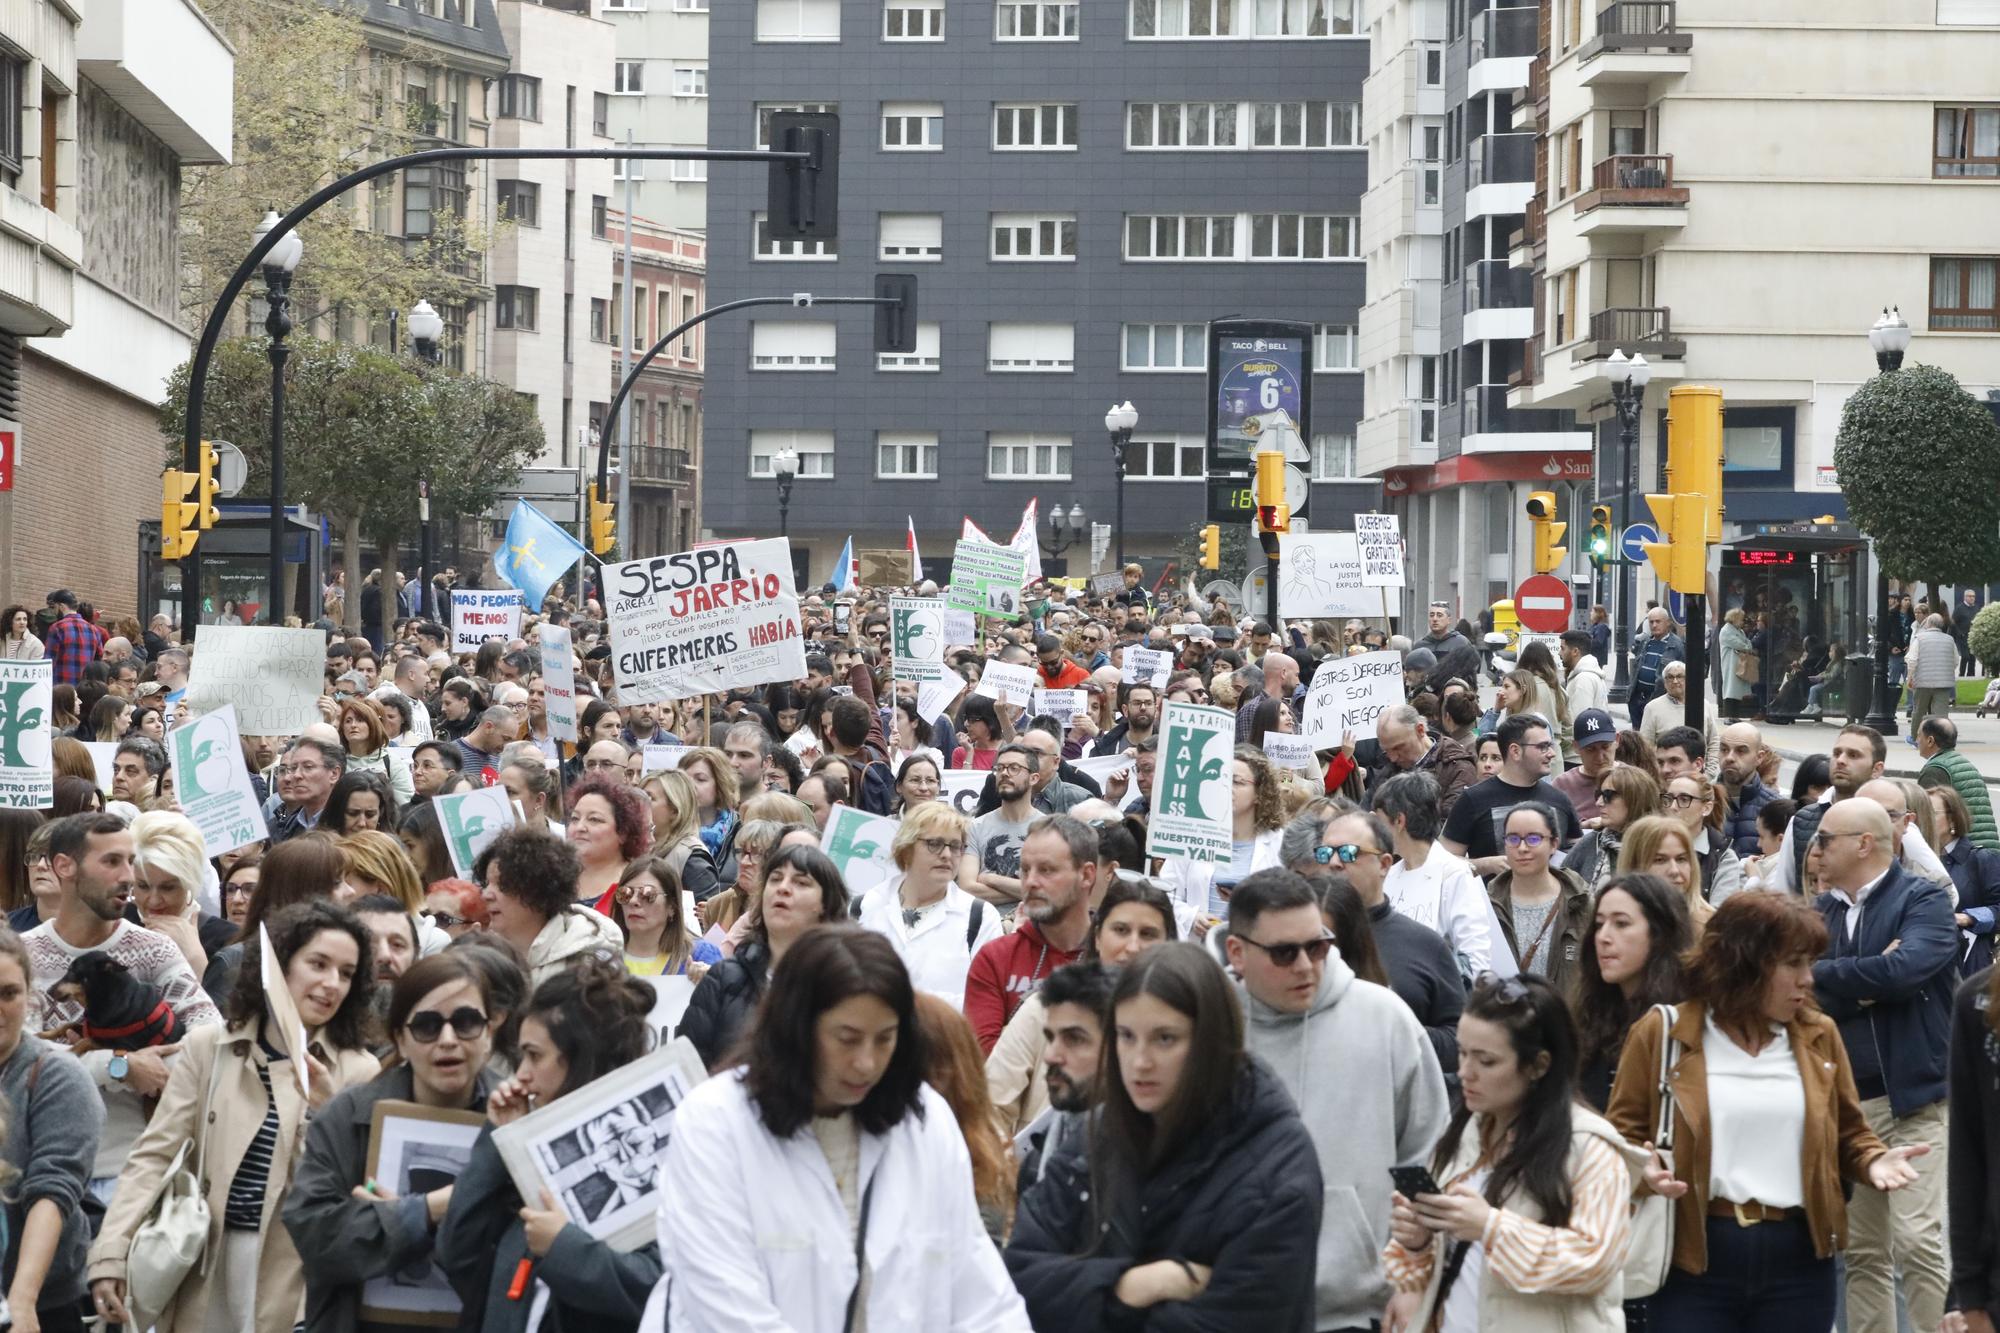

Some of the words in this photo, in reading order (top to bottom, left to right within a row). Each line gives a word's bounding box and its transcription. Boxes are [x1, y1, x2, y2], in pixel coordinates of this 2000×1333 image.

[1232, 342, 1253, 350] TACO
[1268, 342, 1288, 351] BELL
[1243, 363, 1278, 373] BURRITO
[619, 546, 742, 598] SESPA
[952, 564, 974, 574] AGOSTO
[1338, 571, 1361, 580] JUSTIF
[953, 586, 979, 595] GESTIONA
[481, 594, 524, 608] PEONES
[891, 600, 943, 609] PLATAFORMA
[463, 612, 508, 626] MENOS
[622, 626, 640, 637] LOS
[741, 604, 752, 612] SE
[620, 632, 738, 675] ENFERMERAS
[279, 658, 319, 679] PARA
[1352, 661, 1402, 682] DERECHOS
[981, 679, 993, 689] QUE
[994, 682, 1014, 692] SOMOS
[288, 682, 302, 706] A
[1317, 693, 1333, 709] NO
[1346, 684, 1372, 700] SON
[1307, 716, 1324, 736] UN
[1341, 704, 1386, 729] NEGOC
[0, 784, 25, 793] STRO
[229, 824, 256, 846] YA!
[1154, 831, 1204, 846] NUESTRO
